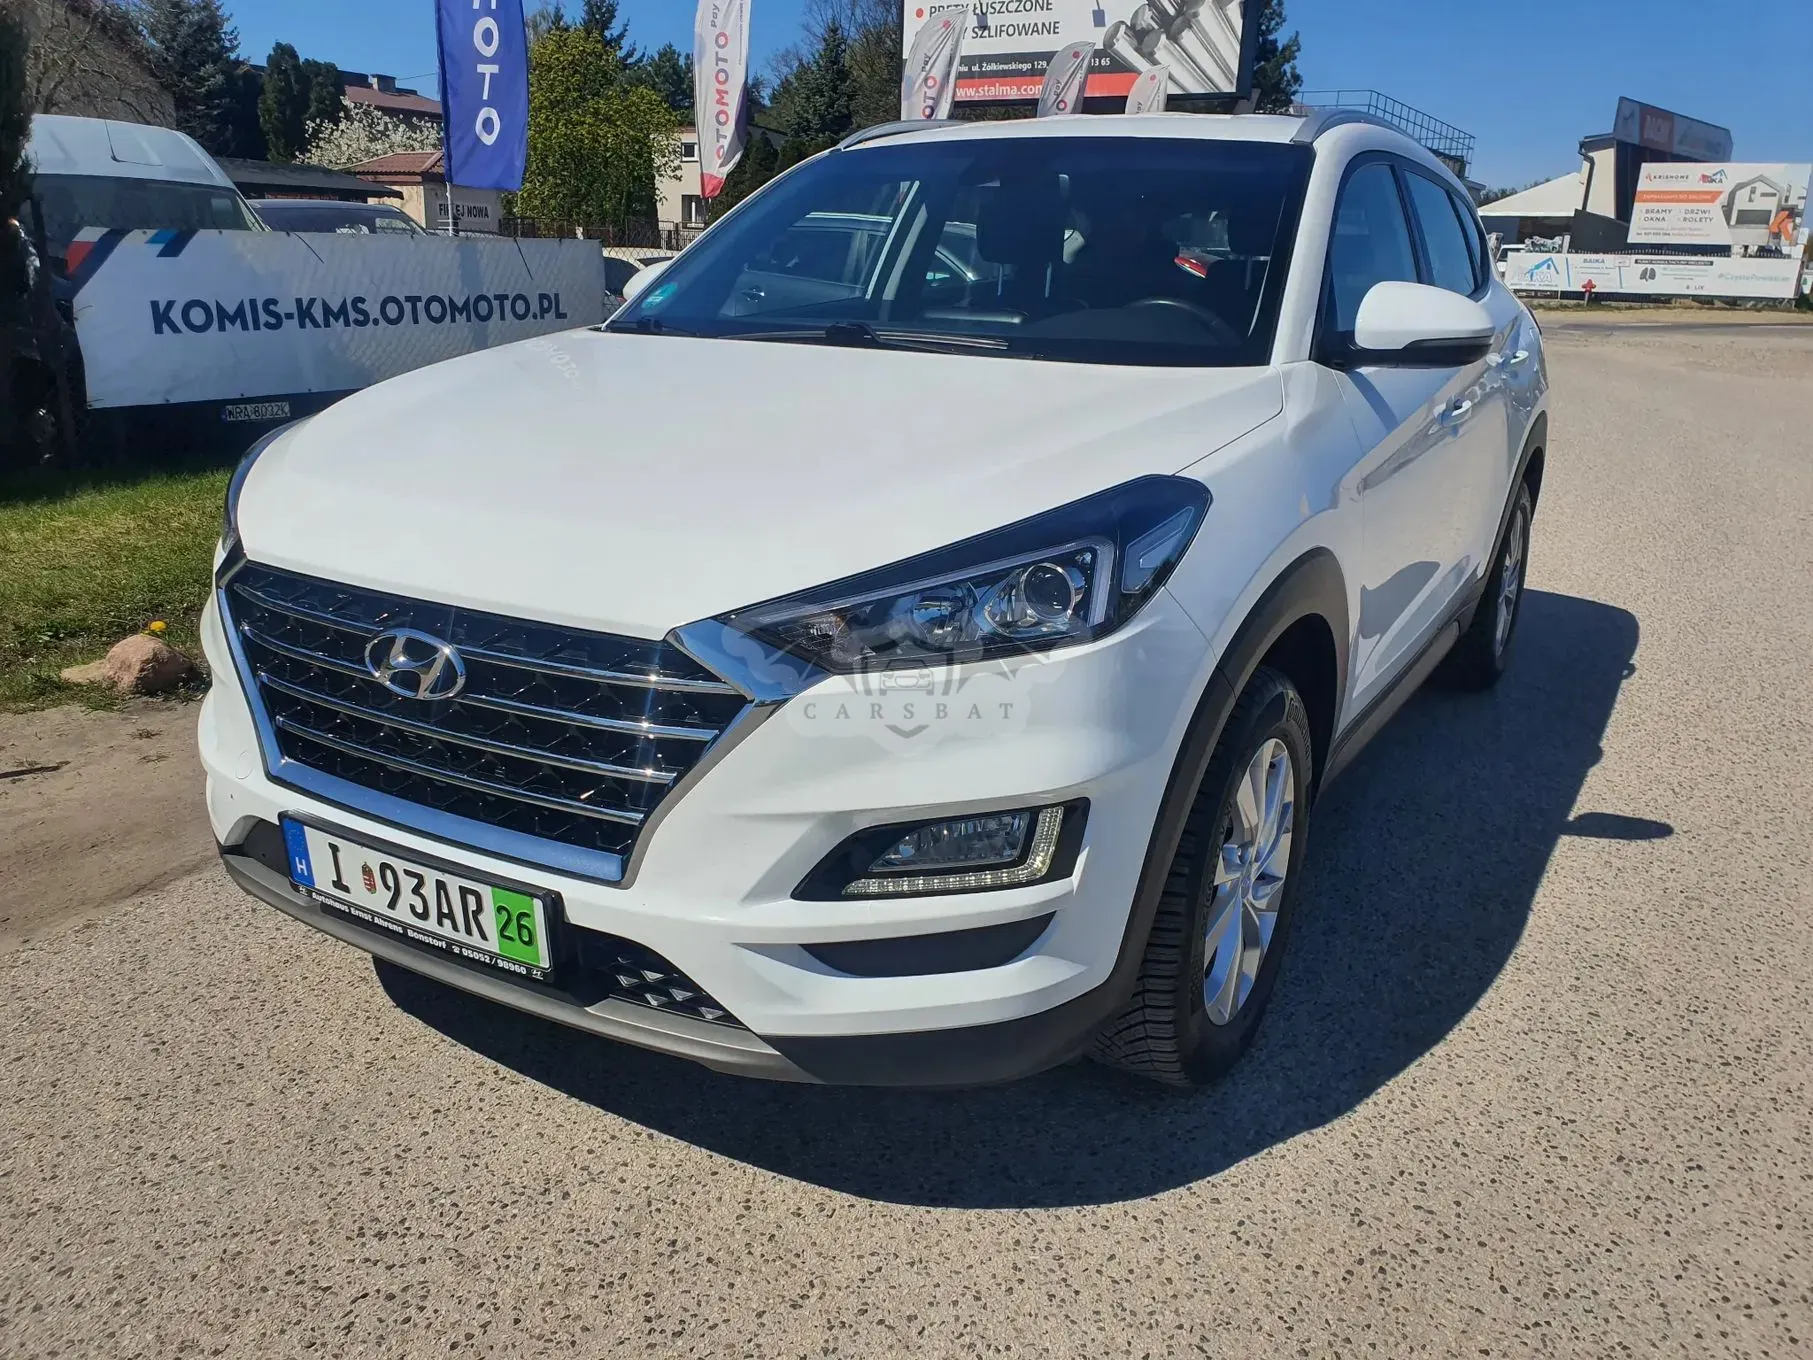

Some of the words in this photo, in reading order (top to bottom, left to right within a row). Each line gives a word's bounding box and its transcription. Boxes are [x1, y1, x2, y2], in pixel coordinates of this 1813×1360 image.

[710, 3, 720, 28] Pay
[971, 21, 1061, 40] SZLIFOWANE
[472, 0, 501, 147] OTO
[466, 205, 490, 219] NOWA
[150, 292, 568, 336] KOMIS-KMS.OTOMOTO.PL
[295, 856, 309, 876] H
[311, 892, 350, 913] Autohaus
[350, 906, 374, 922] Ernst
[378, 861, 490, 942] 93AR
[495, 903, 536, 947] 26
